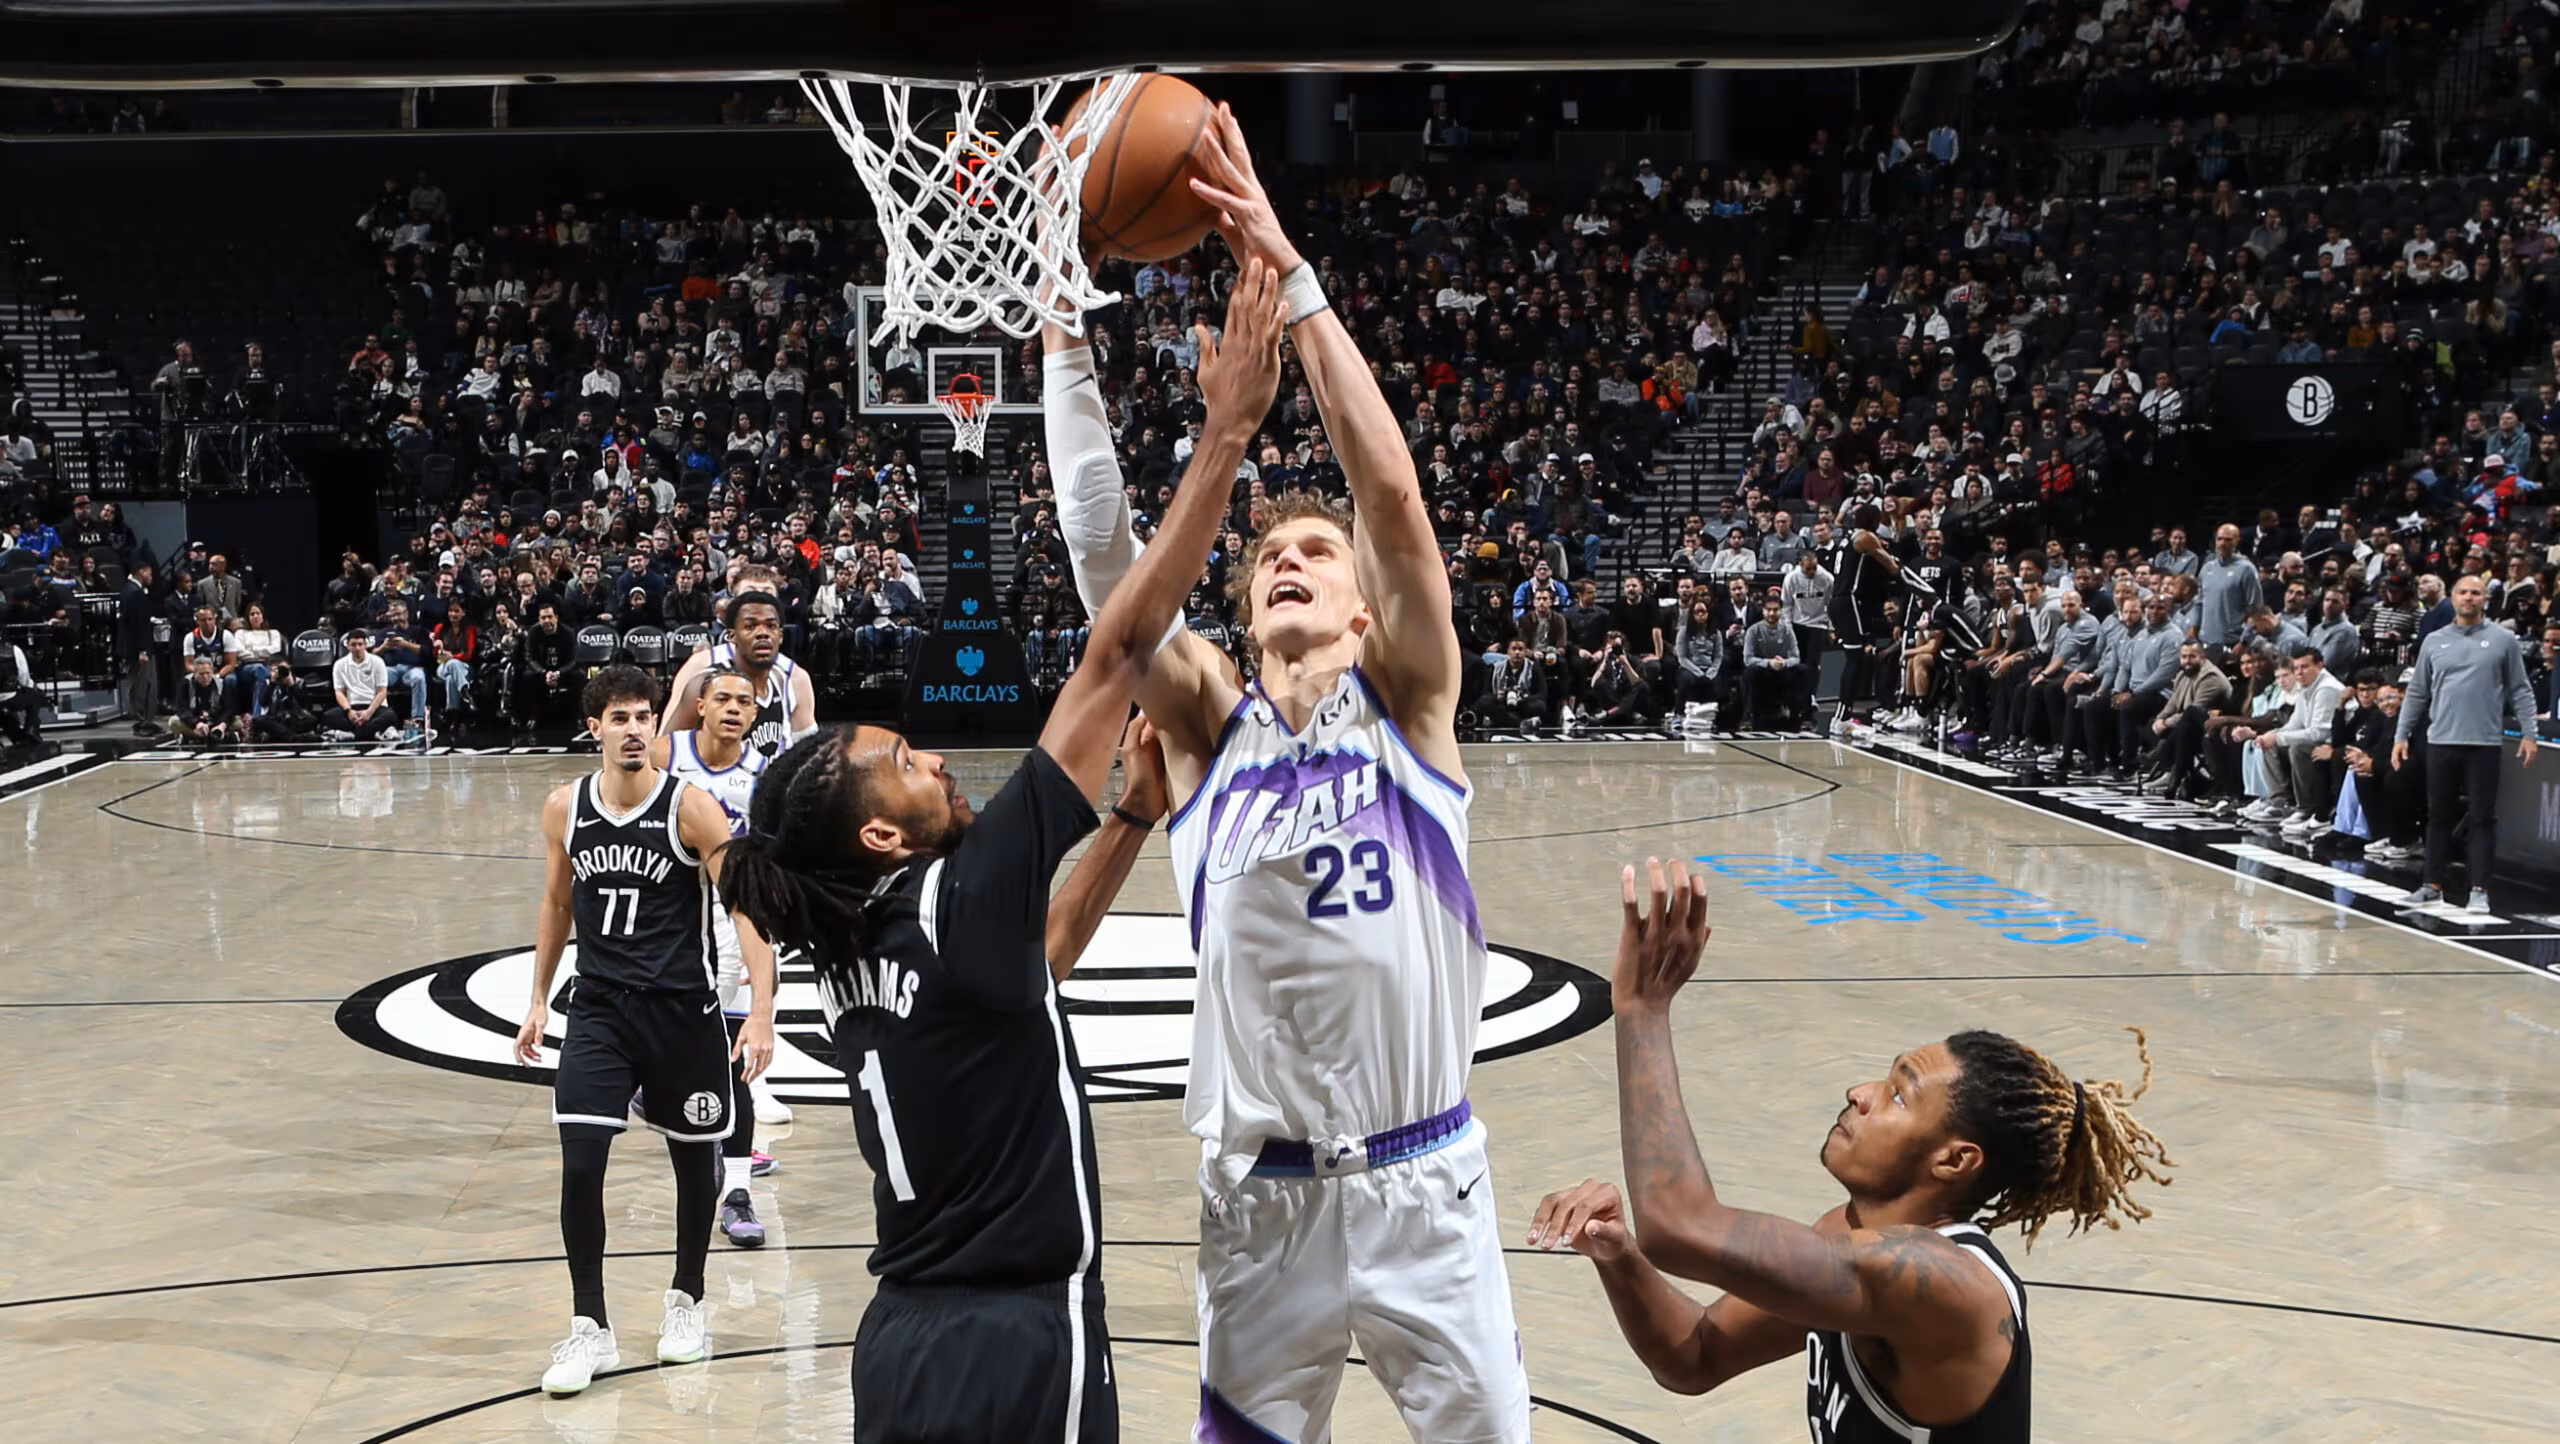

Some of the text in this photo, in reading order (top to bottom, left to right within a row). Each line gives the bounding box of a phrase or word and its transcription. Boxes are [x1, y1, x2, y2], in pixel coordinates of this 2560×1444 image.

[952, 561, 986, 569] BARCLAYS
[675, 633, 708, 643] QATAR
[943, 620, 998, 630] BARCLAYS
[298, 638, 330, 649] QATAR
[581, 634, 614, 645] QATAR
[629, 634, 662, 645] QATAR
[923, 685, 1019, 702] BARCLAYS
[1205, 758, 1381, 884] UTAH
[571, 844, 674, 884] BROOKLYN
[1304, 838, 1394, 919] 23
[1693, 853, 1926, 925] CENTER
[598, 887, 640, 936] 77
[1827, 853, 2149, 945] BARCLAYS
[858, 1049, 916, 1201] 1
